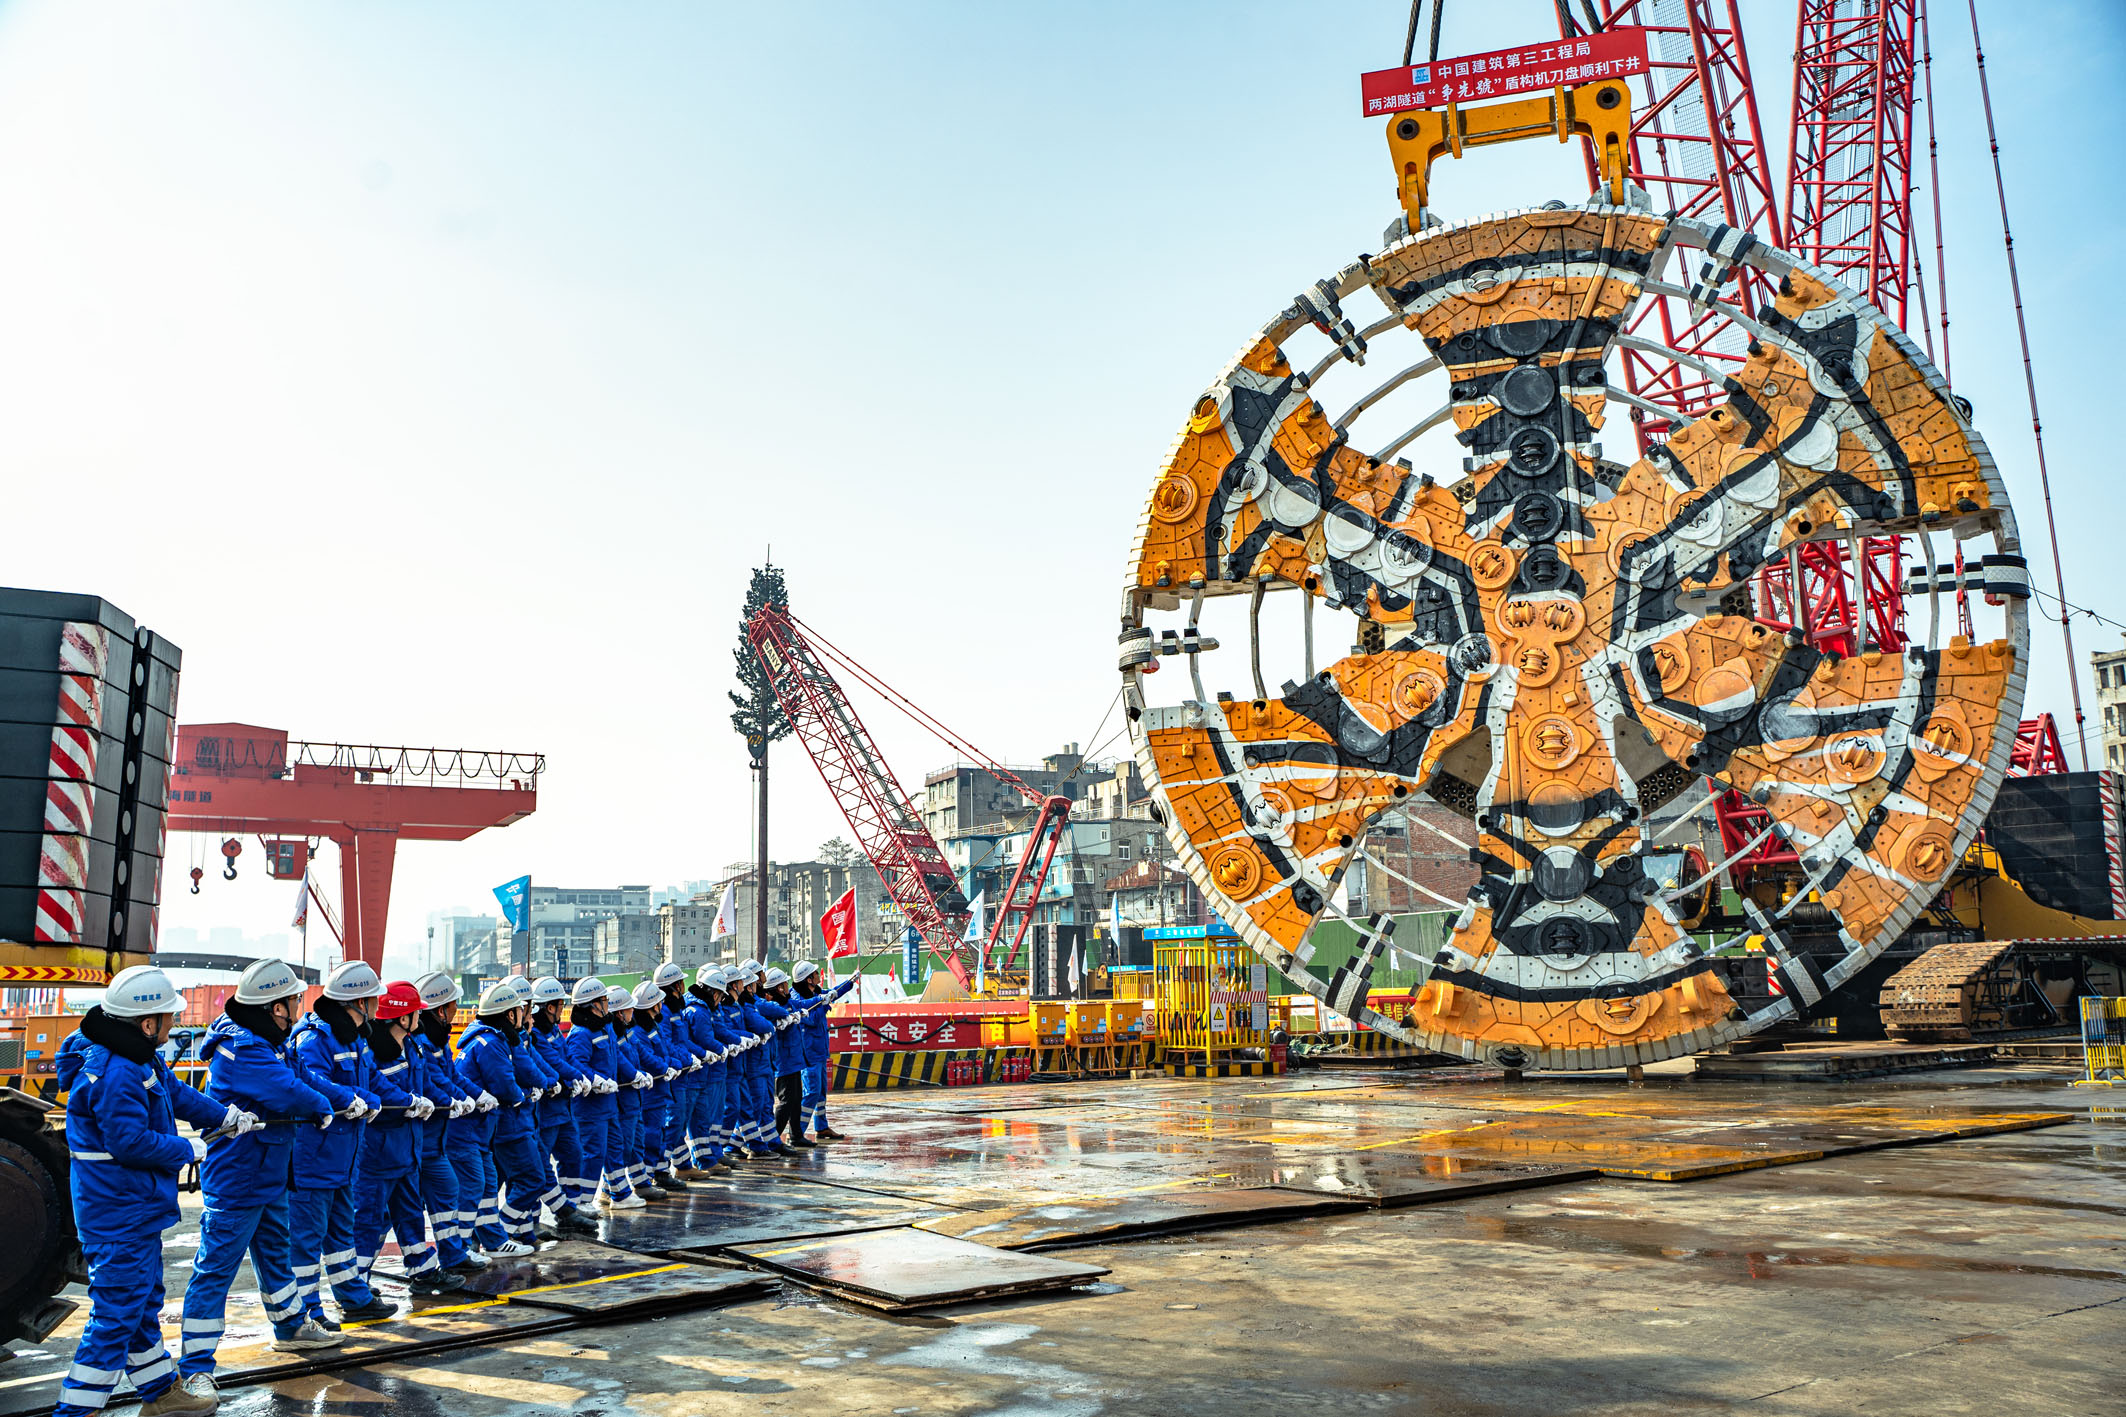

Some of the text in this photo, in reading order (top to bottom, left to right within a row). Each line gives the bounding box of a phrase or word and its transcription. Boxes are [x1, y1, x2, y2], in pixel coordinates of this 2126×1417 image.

[1438, 42, 1591, 79] 中国建筑第三工程局
[764, 641, 780, 668] SANY
